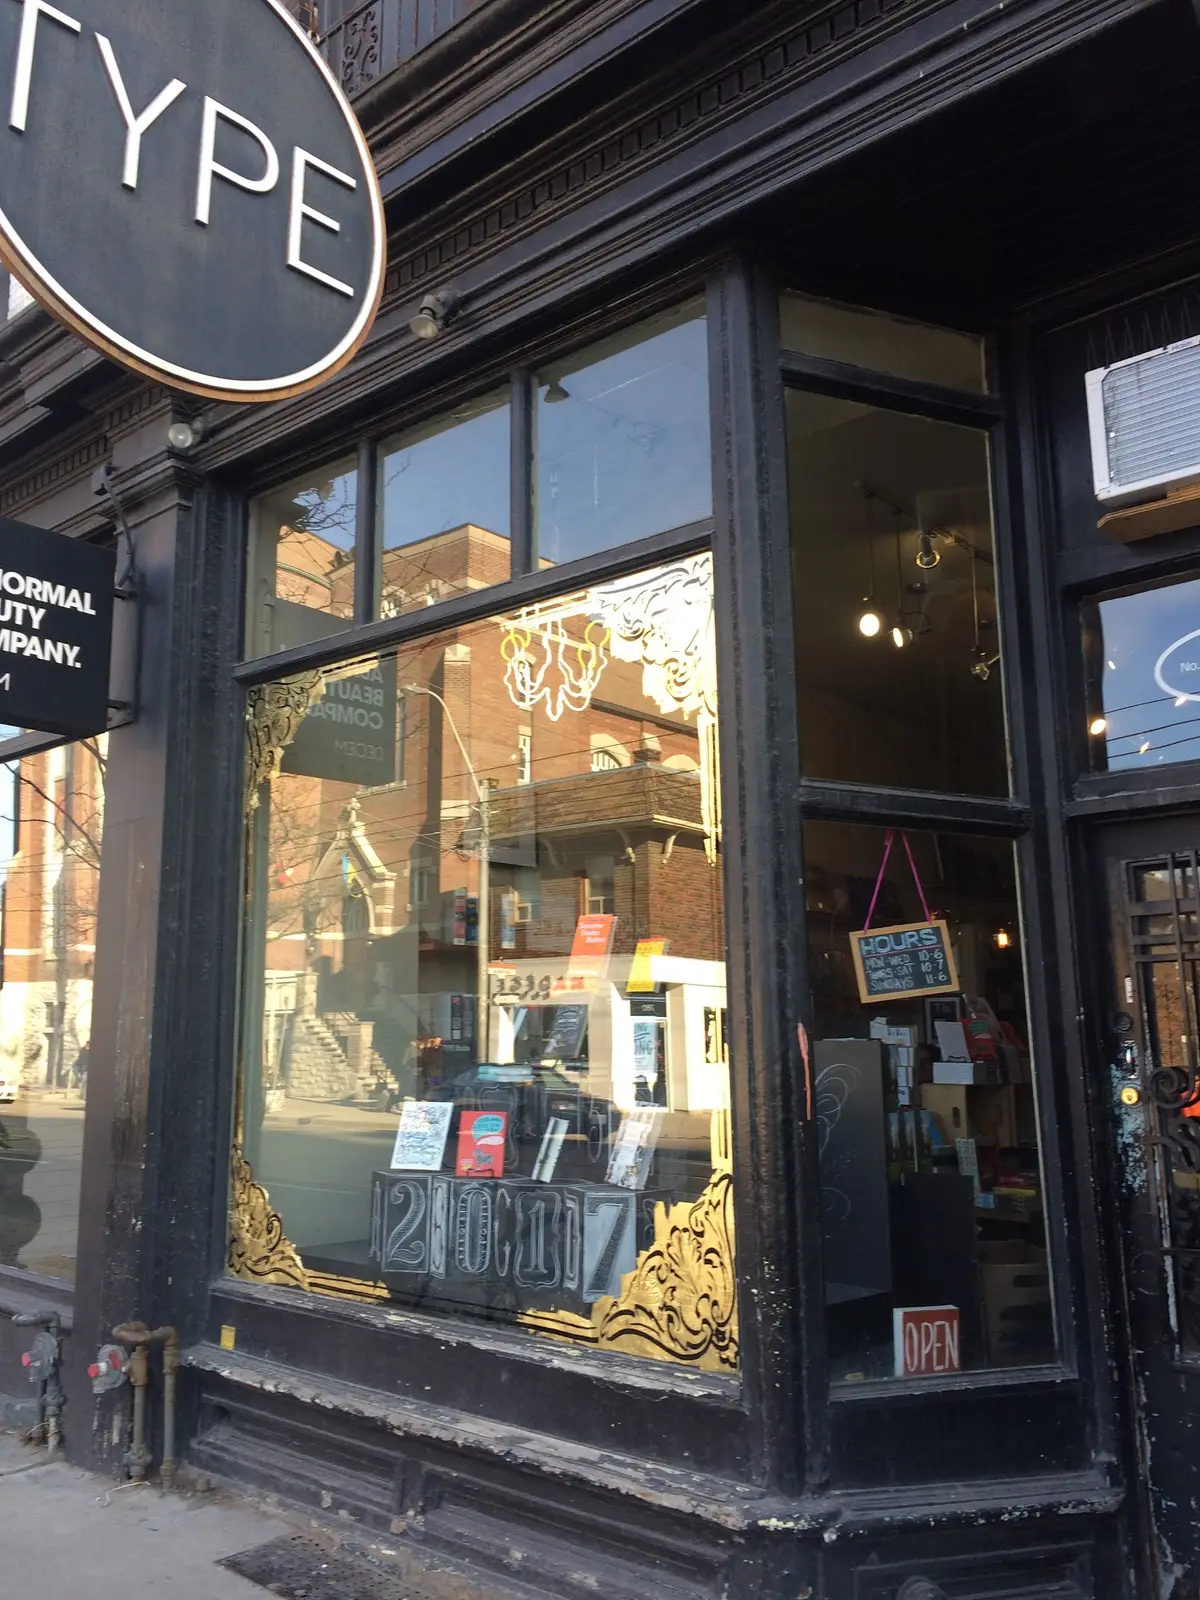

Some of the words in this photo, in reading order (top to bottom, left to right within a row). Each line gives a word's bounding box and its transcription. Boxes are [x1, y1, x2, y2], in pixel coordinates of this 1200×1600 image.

[10, 0, 357, 297] TYPE
[860, 929, 937, 955] HOURS
[905, 1320, 960, 1372] OPEN
